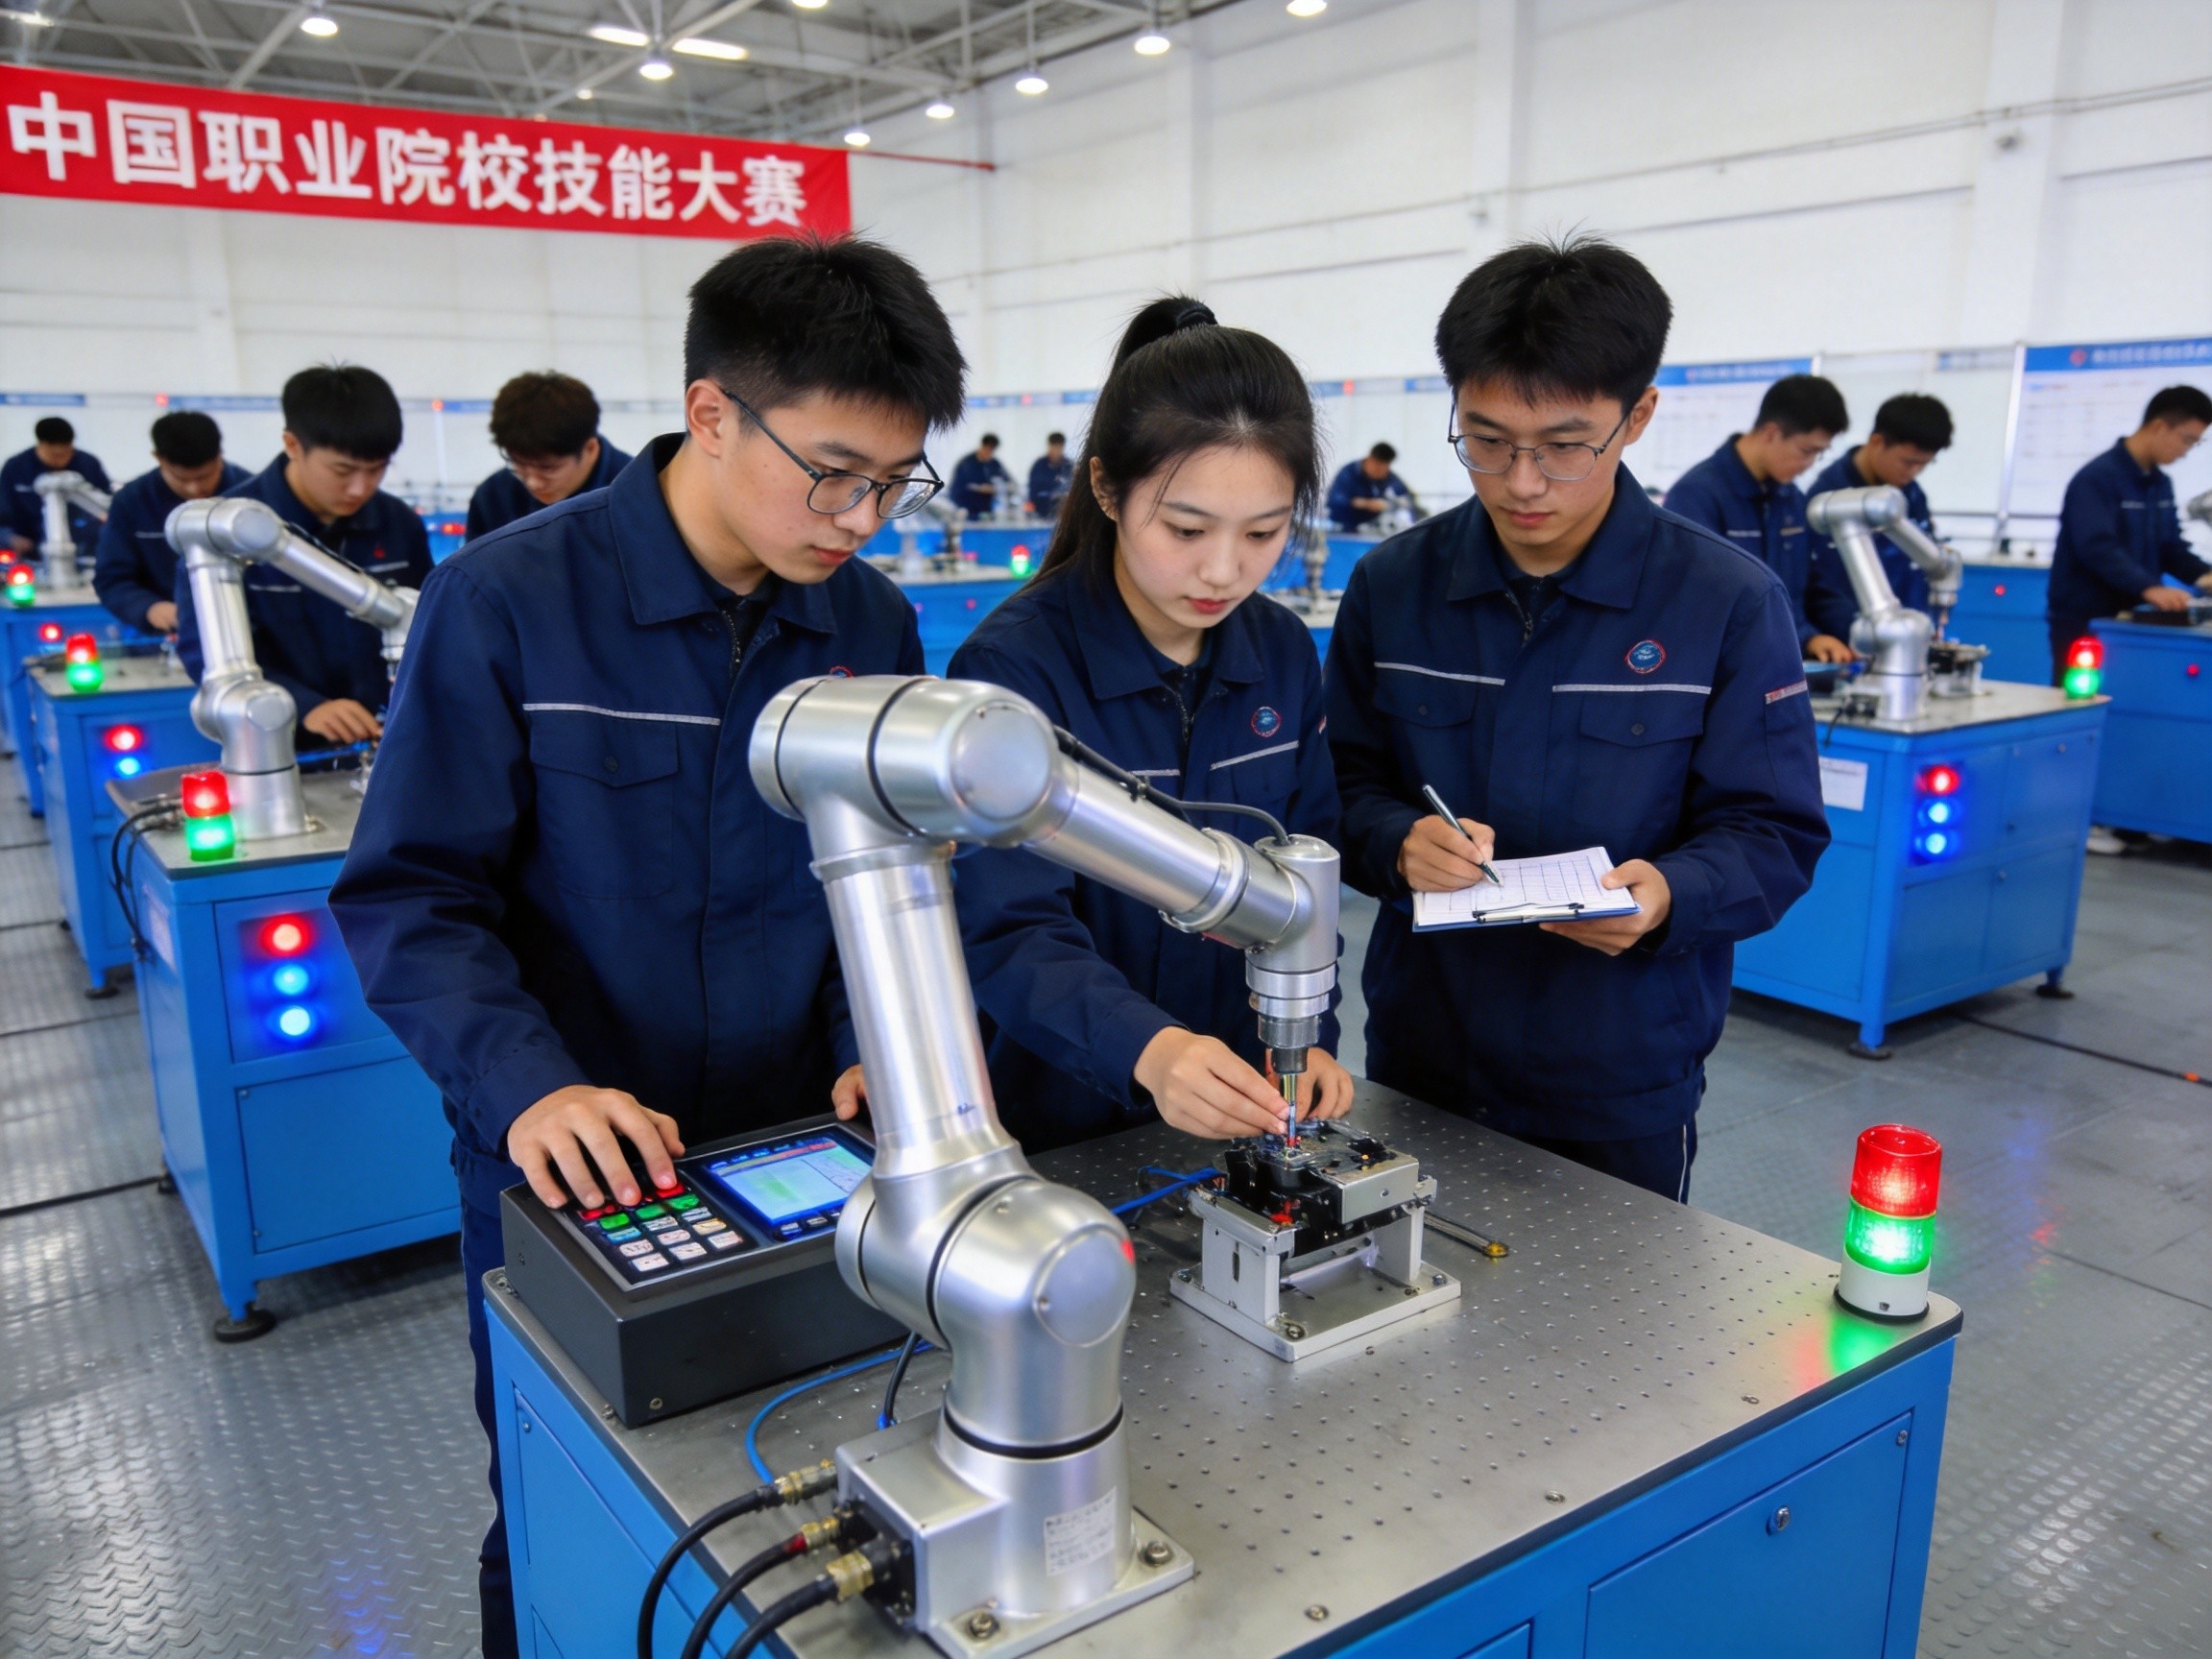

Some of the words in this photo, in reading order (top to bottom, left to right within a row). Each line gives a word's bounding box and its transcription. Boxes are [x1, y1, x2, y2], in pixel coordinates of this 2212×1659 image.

[7, 91, 807, 227] 中国职业院校技能大赛
